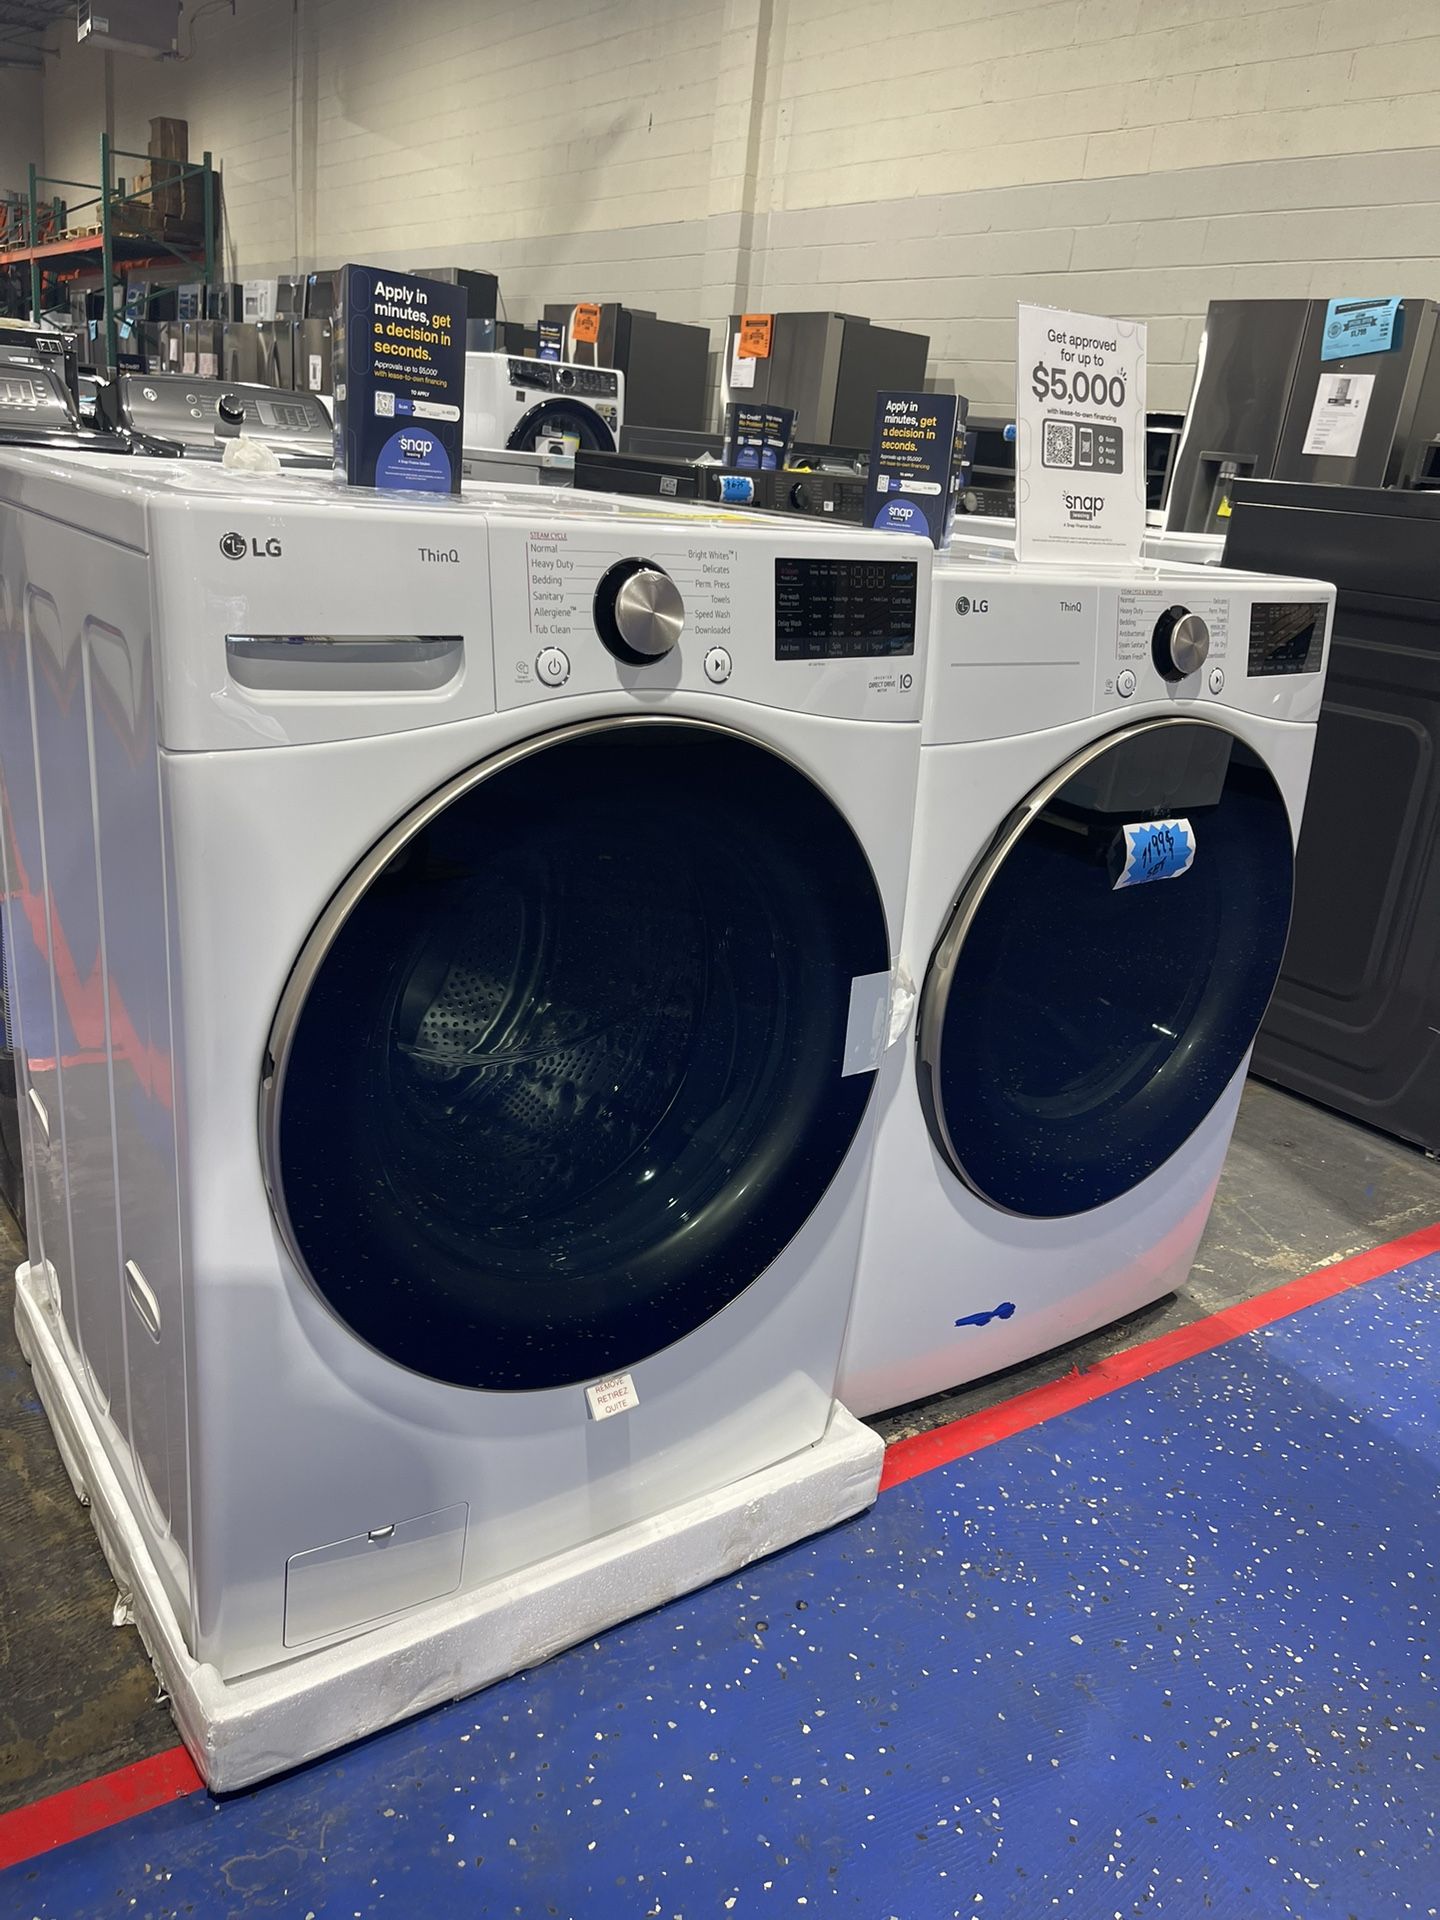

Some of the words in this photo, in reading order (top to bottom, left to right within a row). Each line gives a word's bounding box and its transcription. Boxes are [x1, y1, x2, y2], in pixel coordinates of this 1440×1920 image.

[374, 282, 414, 304] Apply
[416, 288, 427, 304] in
[374, 302, 430, 326] minutes,
[432, 314, 451, 329] get
[374, 322, 383, 334] a
[386, 322, 438, 344] decision
[441, 332, 450, 346] in
[1047, 329, 1067, 344] Get
[1069, 335, 1117, 352] approved
[374, 341, 432, 360] seconds.
[1060, 348, 1075, 362] for
[1078, 354, 1091, 367] up
[1094, 354, 1104, 366] to
[374, 360, 403, 371] Approvals
[388, 371, 424, 383] lease-to-own
[425, 377, 448, 388] financing
[1032, 360, 1125, 408] $5,000
[886, 400, 909, 413] Apply
[910, 401, 918, 412] in
[884, 414, 919, 427] minutes,
[920, 417, 937, 428] get
[1060, 409, 1092, 418] lease-to-own
[1094, 413, 1117, 423] financing
[889, 427, 924, 439] decision
[926, 429, 935, 439] in
[400, 438, 432, 456] snap
[882, 441, 917, 451] seconds.
[1065, 495, 1104, 516] snap
[889, 506, 913, 520] snap
[530, 532, 549, 540] STEAM
[252, 538, 282, 558] LG
[531, 544, 558, 553] Normal
[418, 548, 460, 563] ThinQ
[688, 549, 707, 561] Bright
[531, 559, 554, 570] Heavy
[556, 560, 574, 571] Duty
[702, 564, 730, 574] Delicates
[532, 575, 562, 587] Bedding
[695, 580, 712, 588] Perm.
[714, 580, 730, 588] Press
[533, 591, 564, 603] Sanitary
[711, 595, 730, 604] Towels
[972, 600, 988, 612] LG
[1060, 602, 1082, 612] ThinQ
[695, 610, 713, 619] Speed
[715, 610, 730, 618] Wash
[535, 625, 548, 634] Tub
[550, 625, 571, 634] Clean
[695, 626, 730, 634] Downloaded
[595, 1378, 624, 1393] REMOVE
[597, 1387, 628, 1405] RETIREZ
[605, 1399, 627, 1414] QUITE
